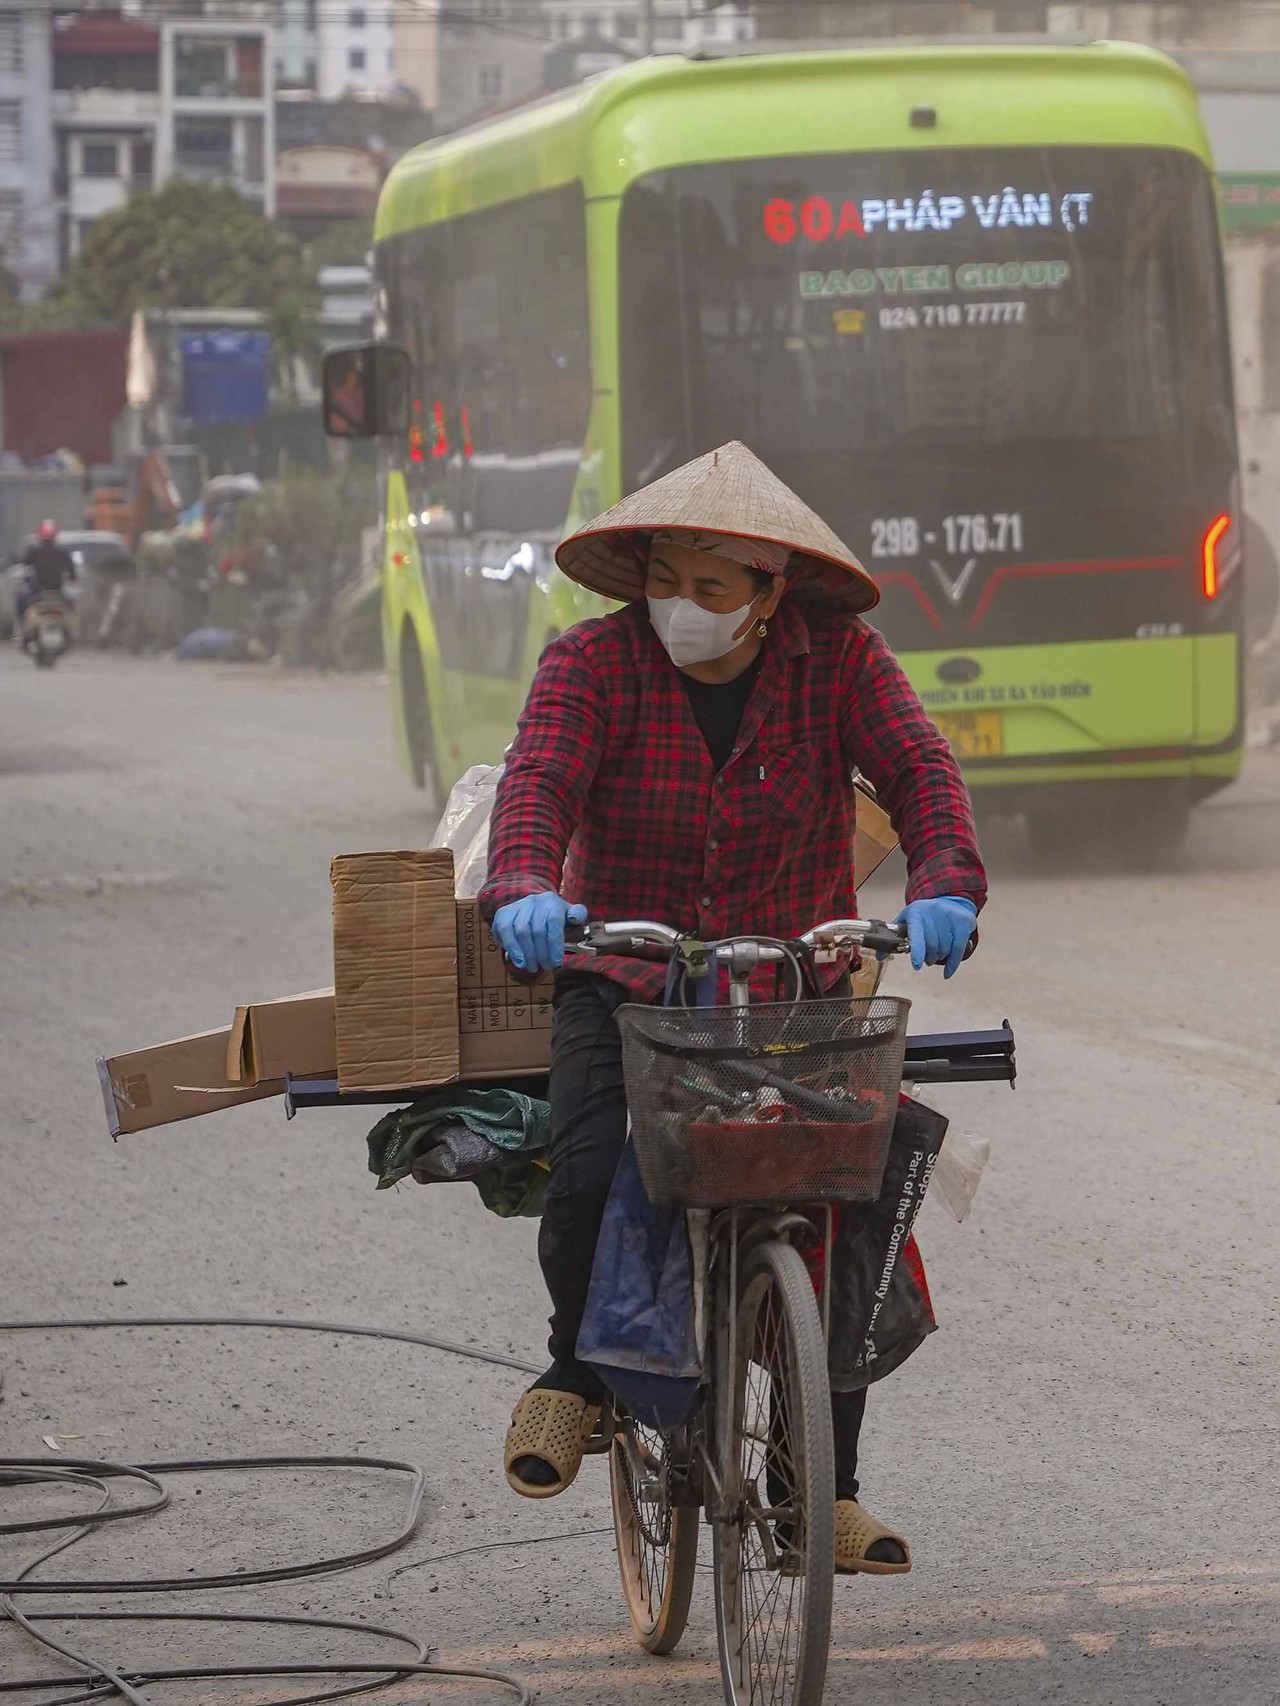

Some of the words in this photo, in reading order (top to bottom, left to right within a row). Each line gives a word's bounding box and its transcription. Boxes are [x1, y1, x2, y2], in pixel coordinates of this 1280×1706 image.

[763, 197, 866, 244] 60A
[861, 189, 966, 233] PHÁP
[970, 186, 1052, 228] VÂN
[955, 260, 1070, 292] GROUP
[964, 301, 1026, 325] 77777
[871, 516, 920, 558] 29B
[942, 512, 1023, 554] 176.71
[465, 906, 475, 941] STOOL
[465, 944, 475, 976] PIANO
[468, 995, 477, 1024] NAME
[489, 990, 499, 1027] MODEL
[908, 1151, 923, 1179] Part
[918, 1152, 937, 1195] Shop
[902, 1181, 913, 1197] of
[896, 1198, 911, 1220] the
[874, 1223, 905, 1300] Community
